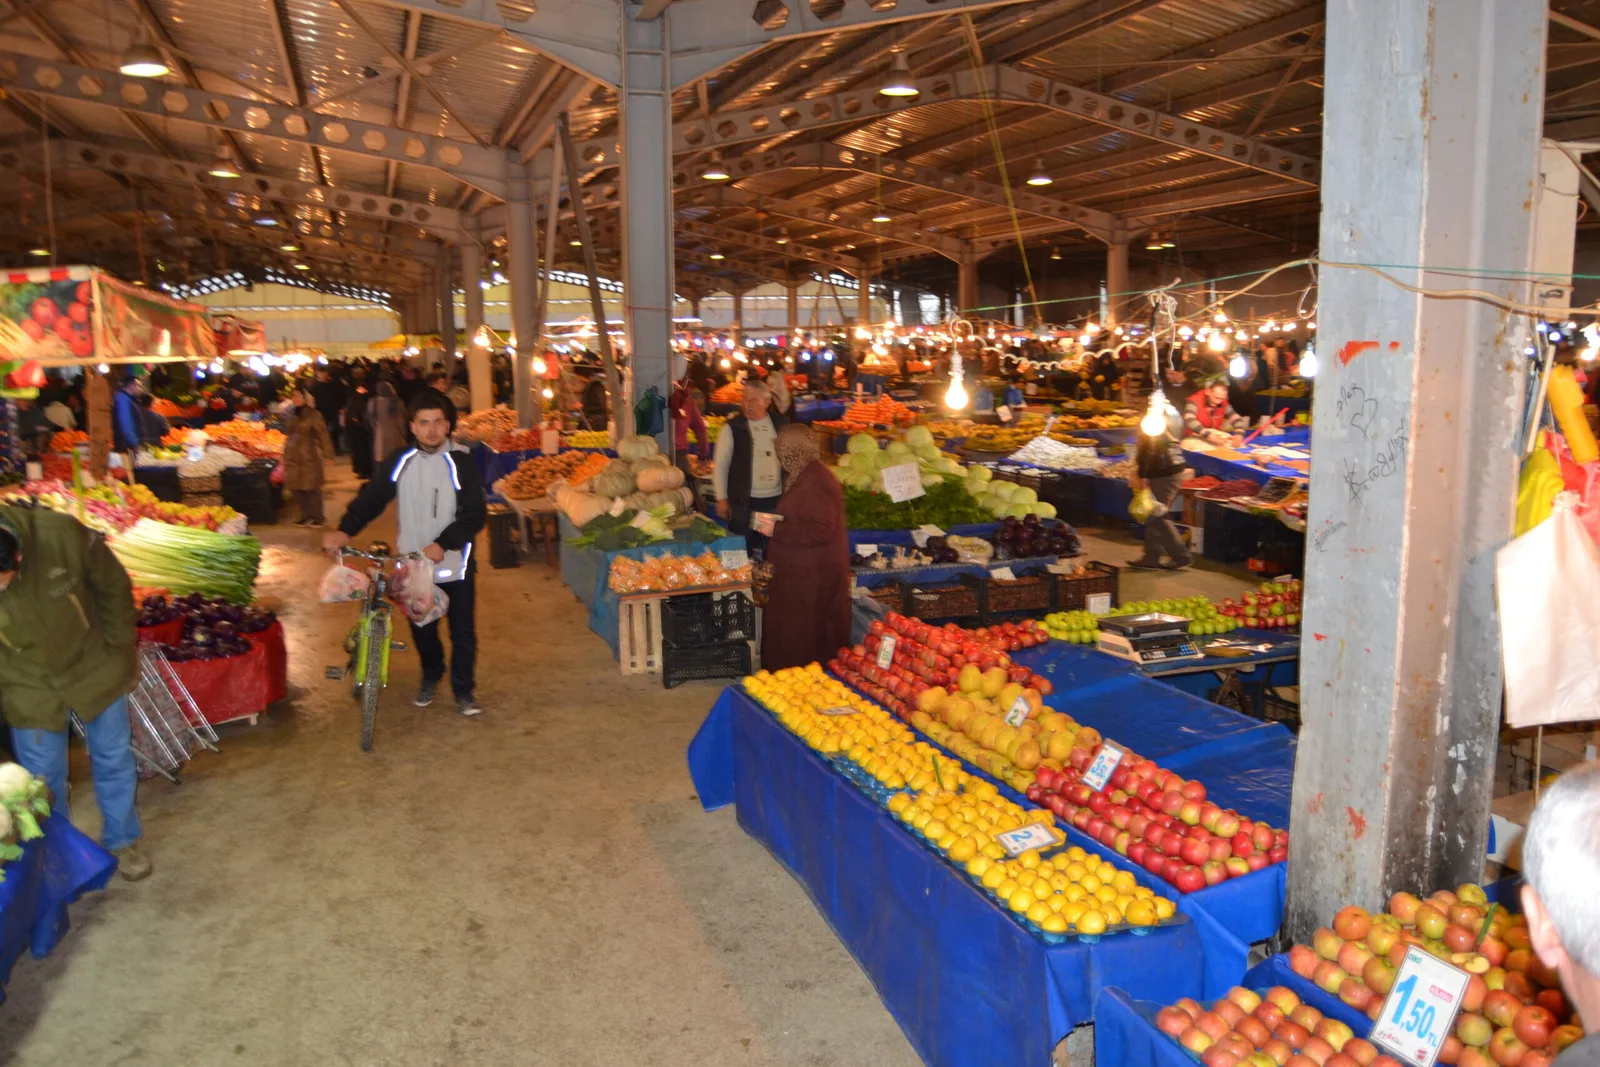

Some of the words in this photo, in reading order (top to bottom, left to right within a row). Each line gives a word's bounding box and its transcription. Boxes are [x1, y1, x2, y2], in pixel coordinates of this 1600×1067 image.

[1010, 830, 1033, 843] 2
[1392, 974, 1435, 1038] 1,50
[1428, 1032, 1438, 1047] TL
